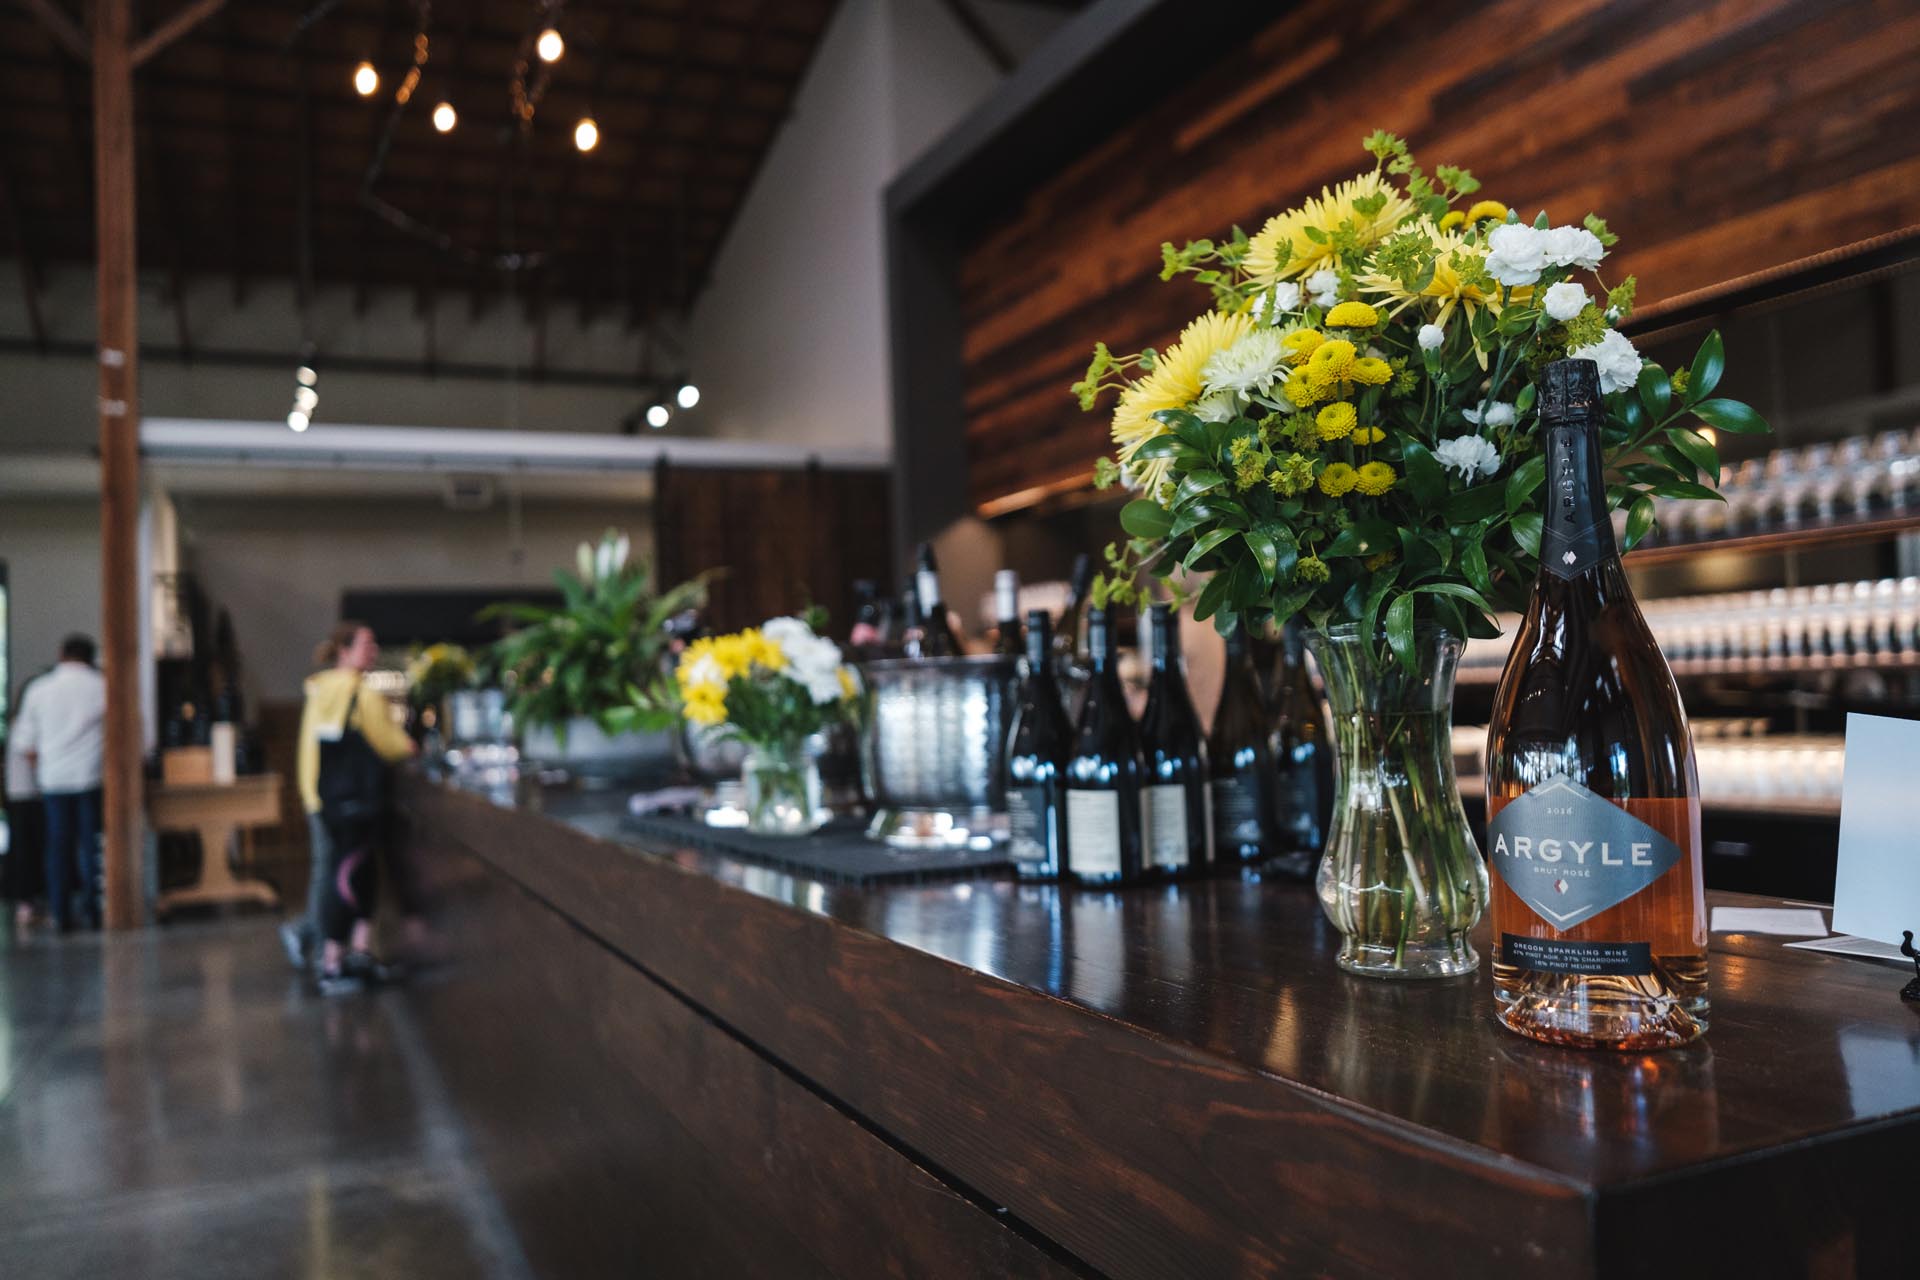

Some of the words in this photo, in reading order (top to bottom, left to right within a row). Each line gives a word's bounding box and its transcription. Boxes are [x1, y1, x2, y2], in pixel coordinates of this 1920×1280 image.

[1495, 833, 1653, 866] ARGYLE
[1534, 866, 1558, 875] BRUT
[1563, 867, 1591, 878] ROSÉ
[1513, 942, 1544, 952] OREGON
[1548, 947, 1599, 956] SPARKLING
[1525, 951, 1541, 959] PINOT
[1549, 961, 1568, 969] PINOT
